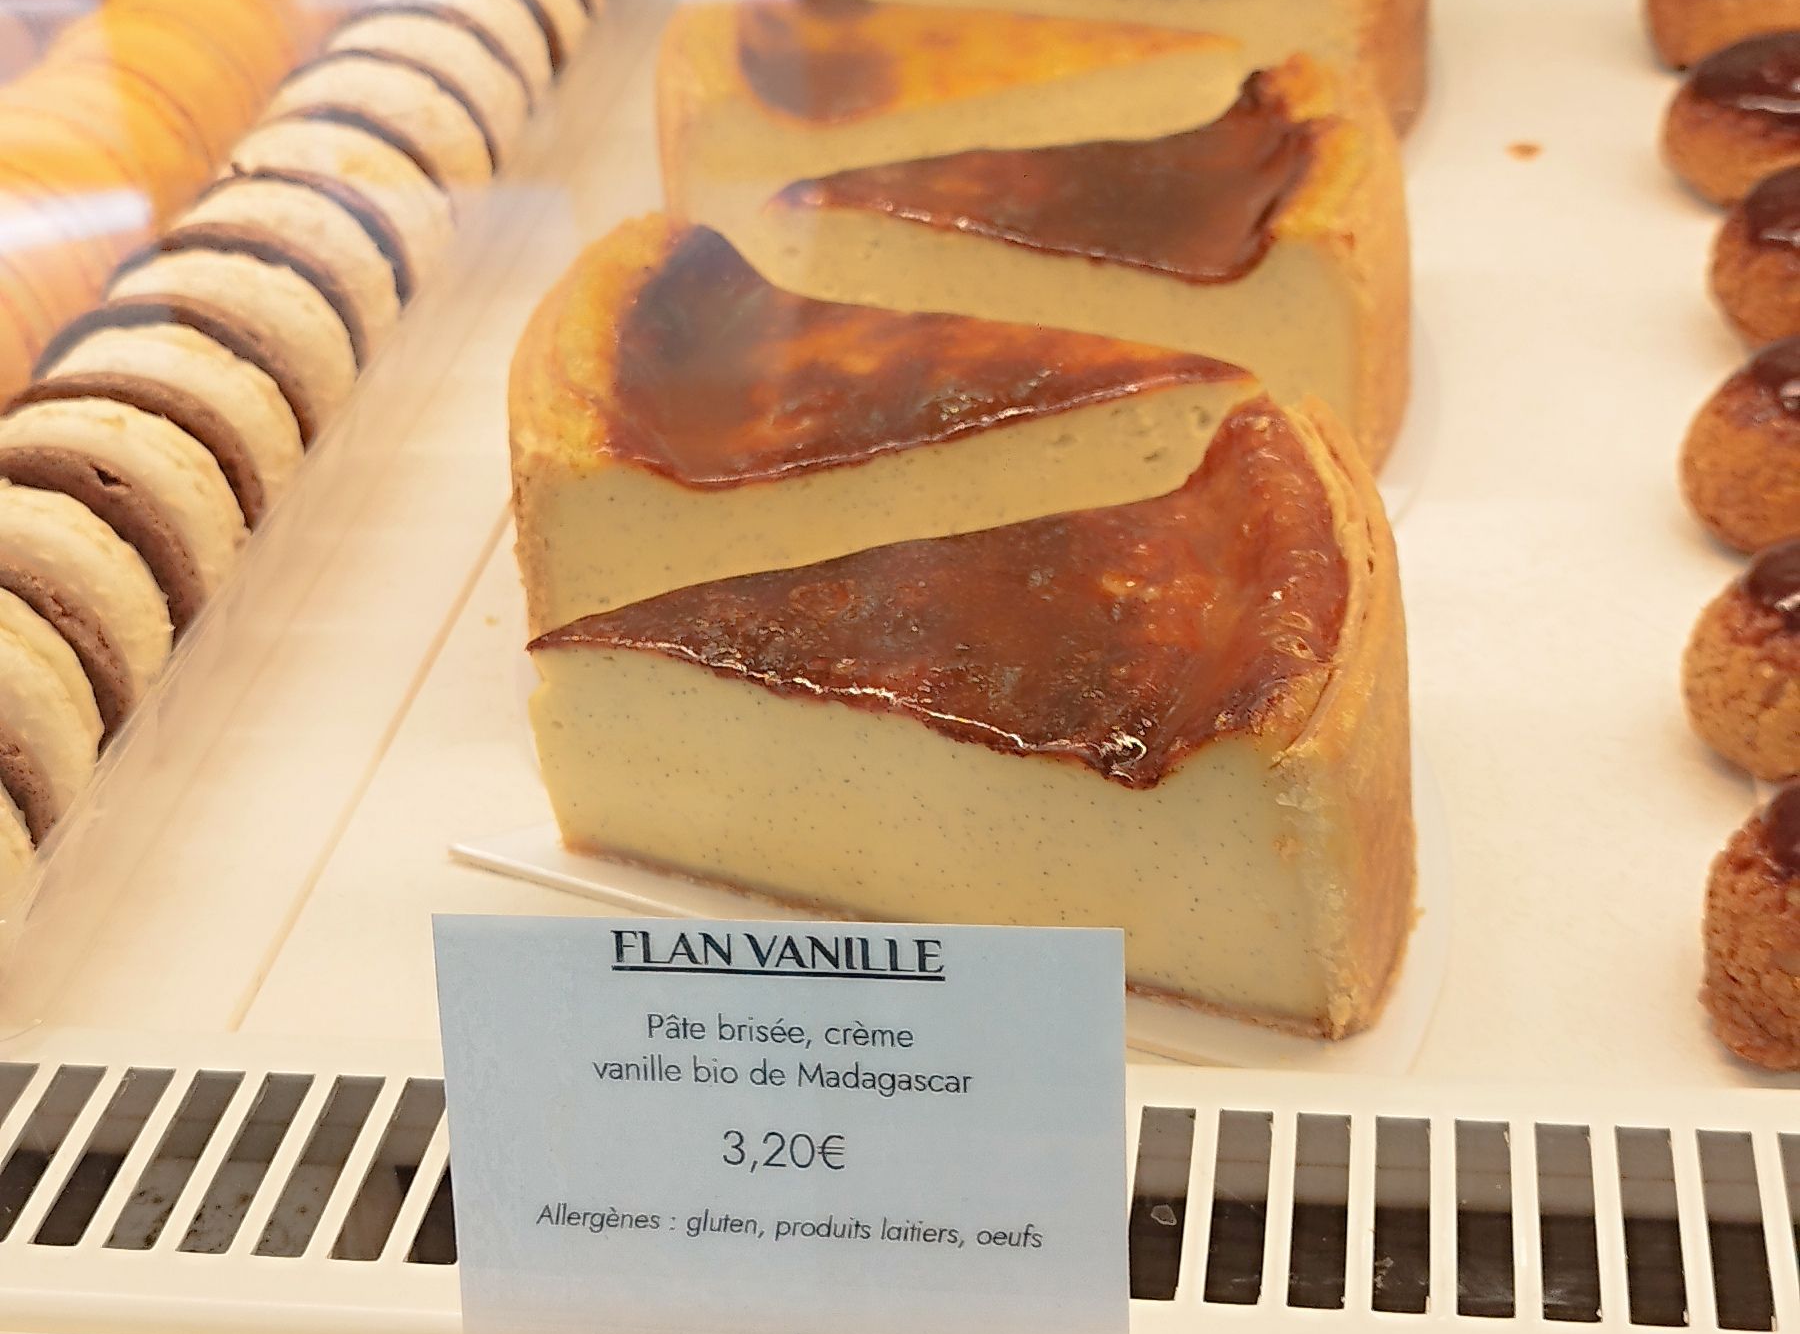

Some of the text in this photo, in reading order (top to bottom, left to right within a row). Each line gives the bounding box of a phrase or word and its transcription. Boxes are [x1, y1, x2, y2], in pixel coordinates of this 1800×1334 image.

[611, 929, 945, 973] FLAN VANILLE
[647, 1013, 914, 1049] Pâte brisée, crème
[592, 1054, 973, 1098] vanille bio de Madagascar
[722, 1129, 846, 1173] 3,20€
[535, 1203, 661, 1234] Allergènes
[686, 1208, 765, 1239] gluten,
[774, 1214, 872, 1242] produits
[880, 1217, 966, 1248] laitiers,
[976, 1223, 1044, 1249] oeufs
